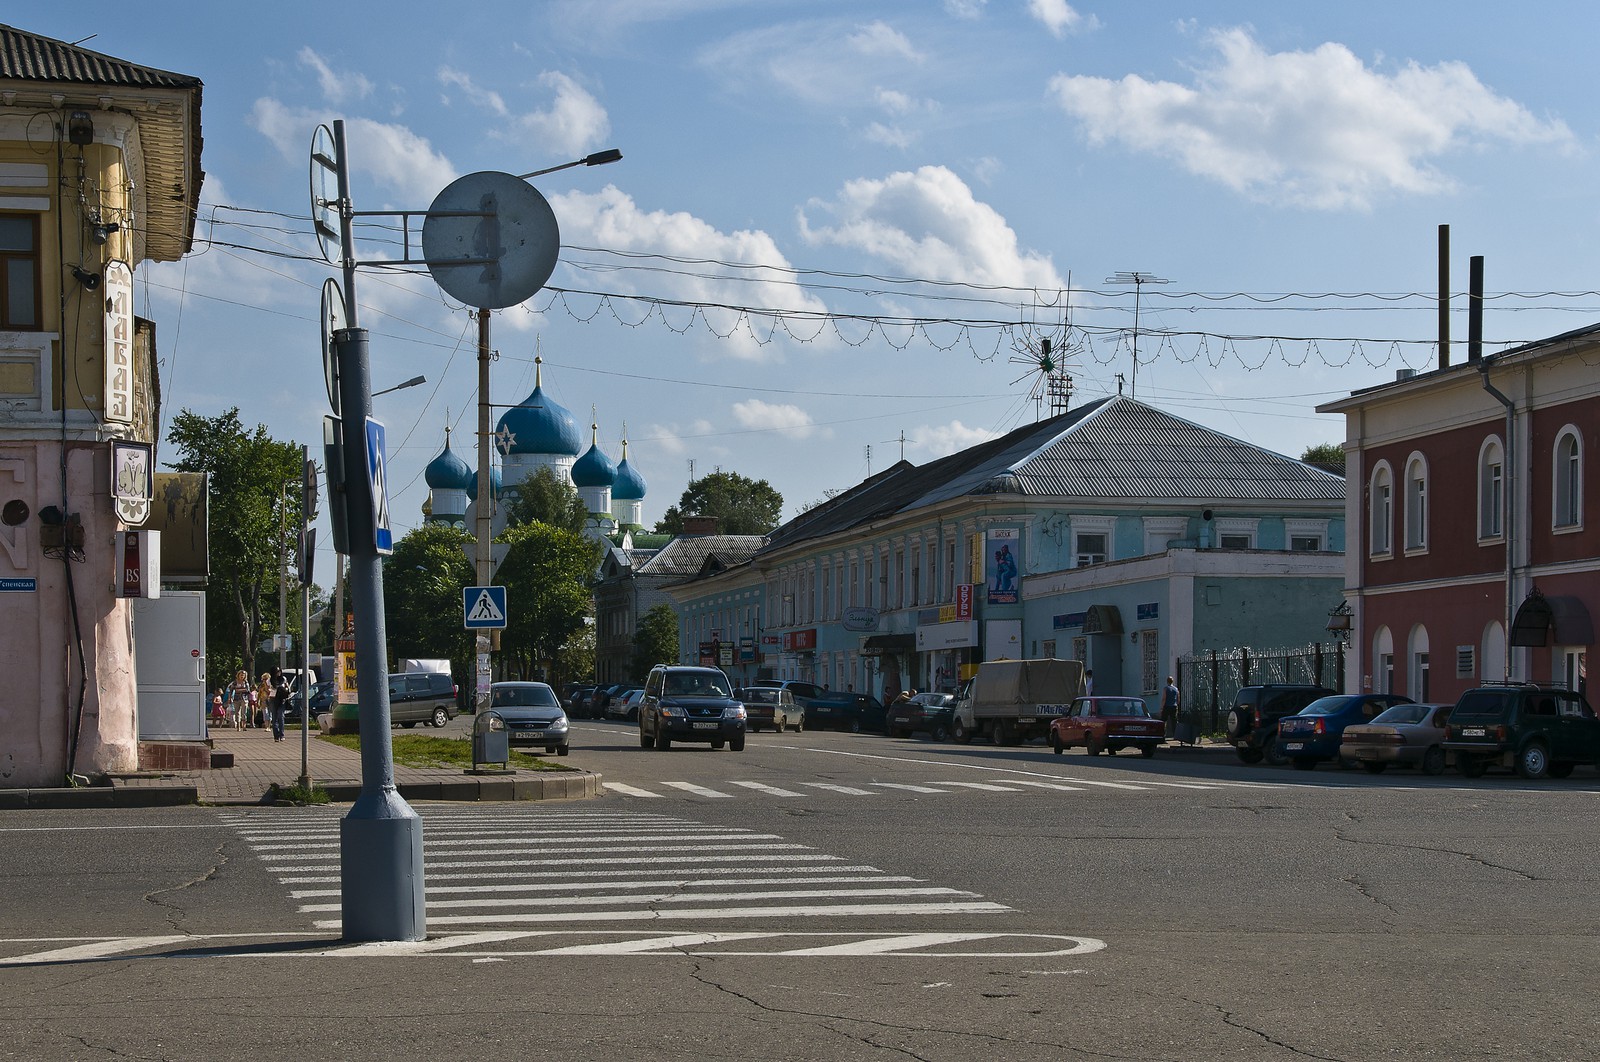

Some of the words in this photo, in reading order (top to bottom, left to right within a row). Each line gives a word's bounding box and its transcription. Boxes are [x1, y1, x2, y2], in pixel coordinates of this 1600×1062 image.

[113, 291, 128, 417] ЛАБАЗ
[126, 569, 140, 583] BS
[960, 586, 969, 616] ОБУВЬ
